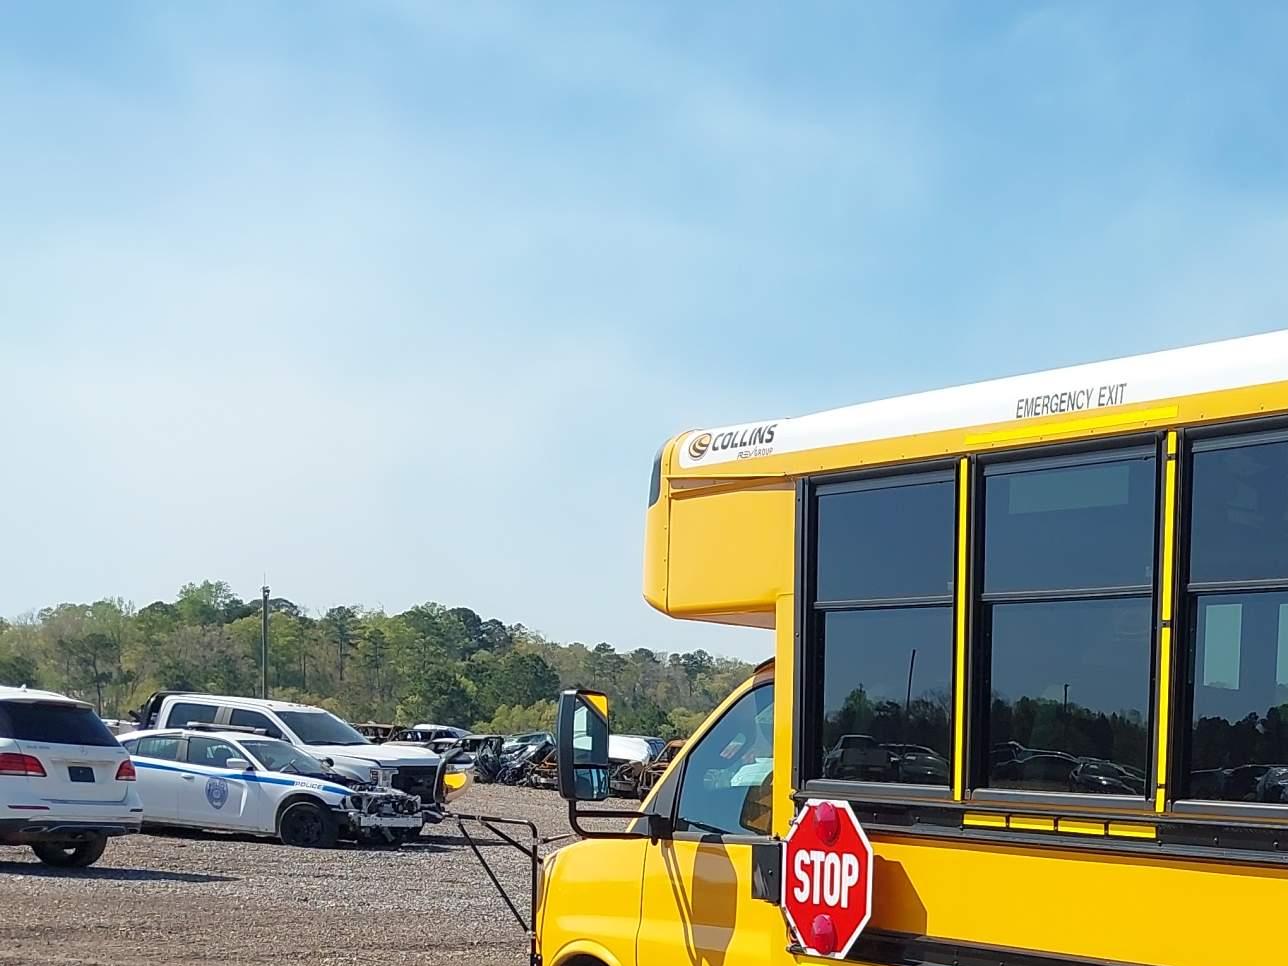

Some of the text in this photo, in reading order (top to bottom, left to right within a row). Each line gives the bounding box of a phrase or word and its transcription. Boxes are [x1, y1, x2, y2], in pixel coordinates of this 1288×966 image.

[1016, 383, 1127, 418] EMERGENCY EXIT
[712, 424, 778, 451] COLLINS
[294, 781, 323, 790] POLICE
[794, 849, 859, 909] STOP
